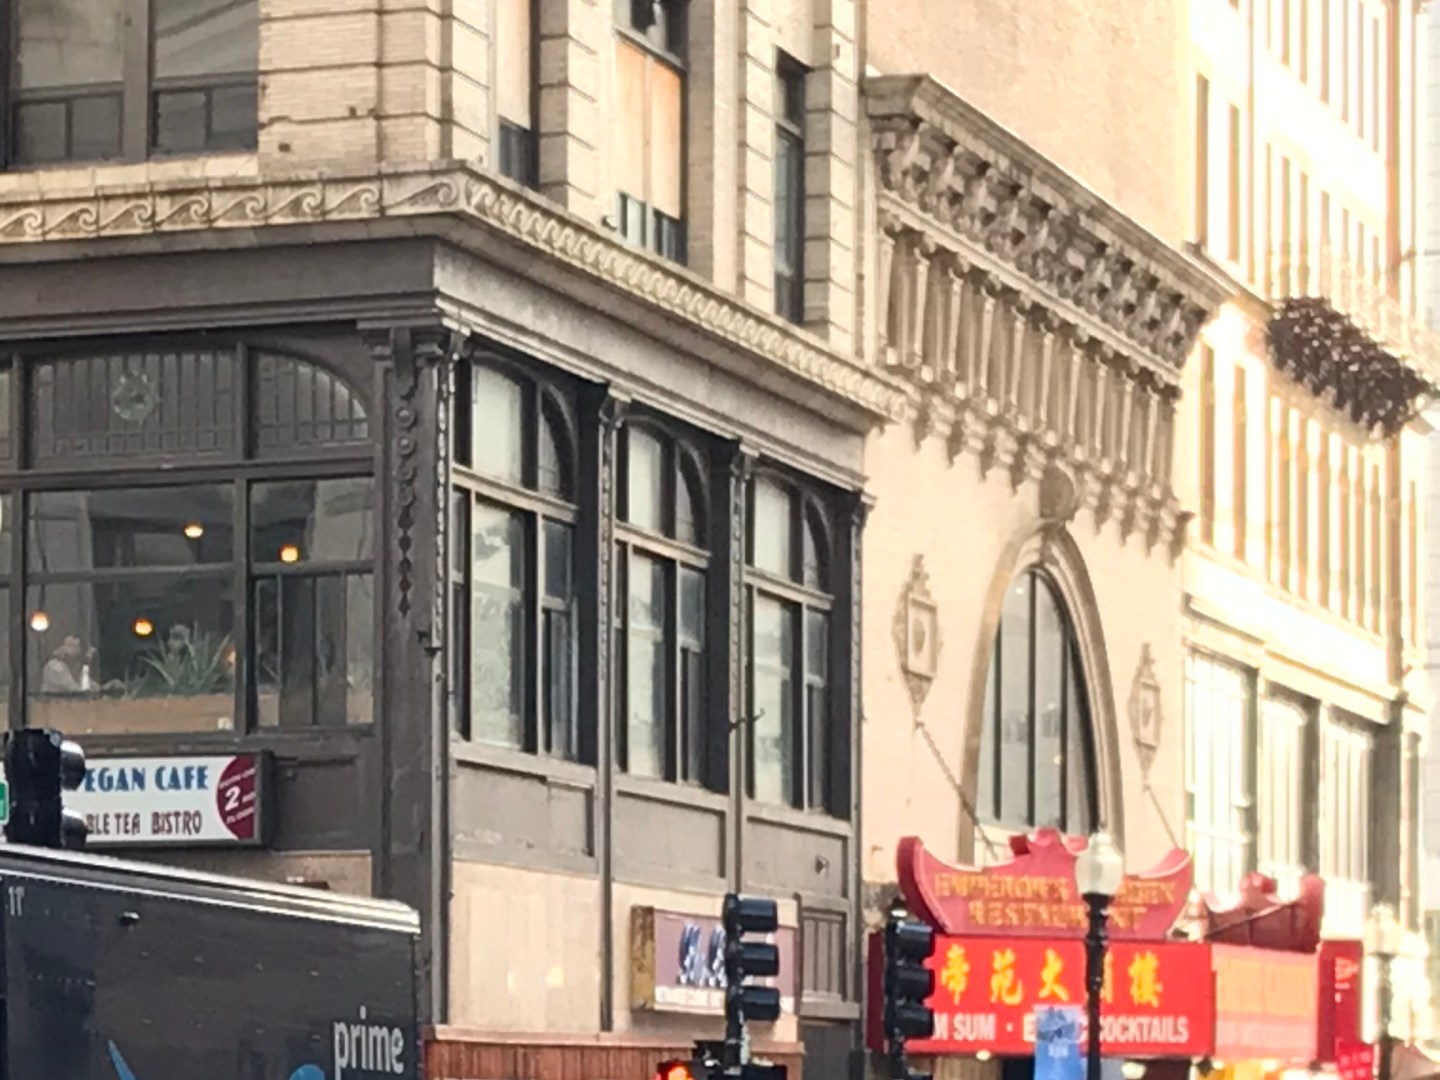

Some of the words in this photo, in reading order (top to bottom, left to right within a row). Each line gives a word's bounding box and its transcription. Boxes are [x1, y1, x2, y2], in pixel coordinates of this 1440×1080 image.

[84, 767, 146, 792] EGAN
[154, 765, 209, 791] CAFE
[114, 811, 141, 836] TEA
[151, 809, 203, 836] BISTRO
[968, 899, 1148, 930] RESTAURNT
[941, 944, 1163, 1008] 帝苑大樓
[953, 1013, 996, 1041] SUM
